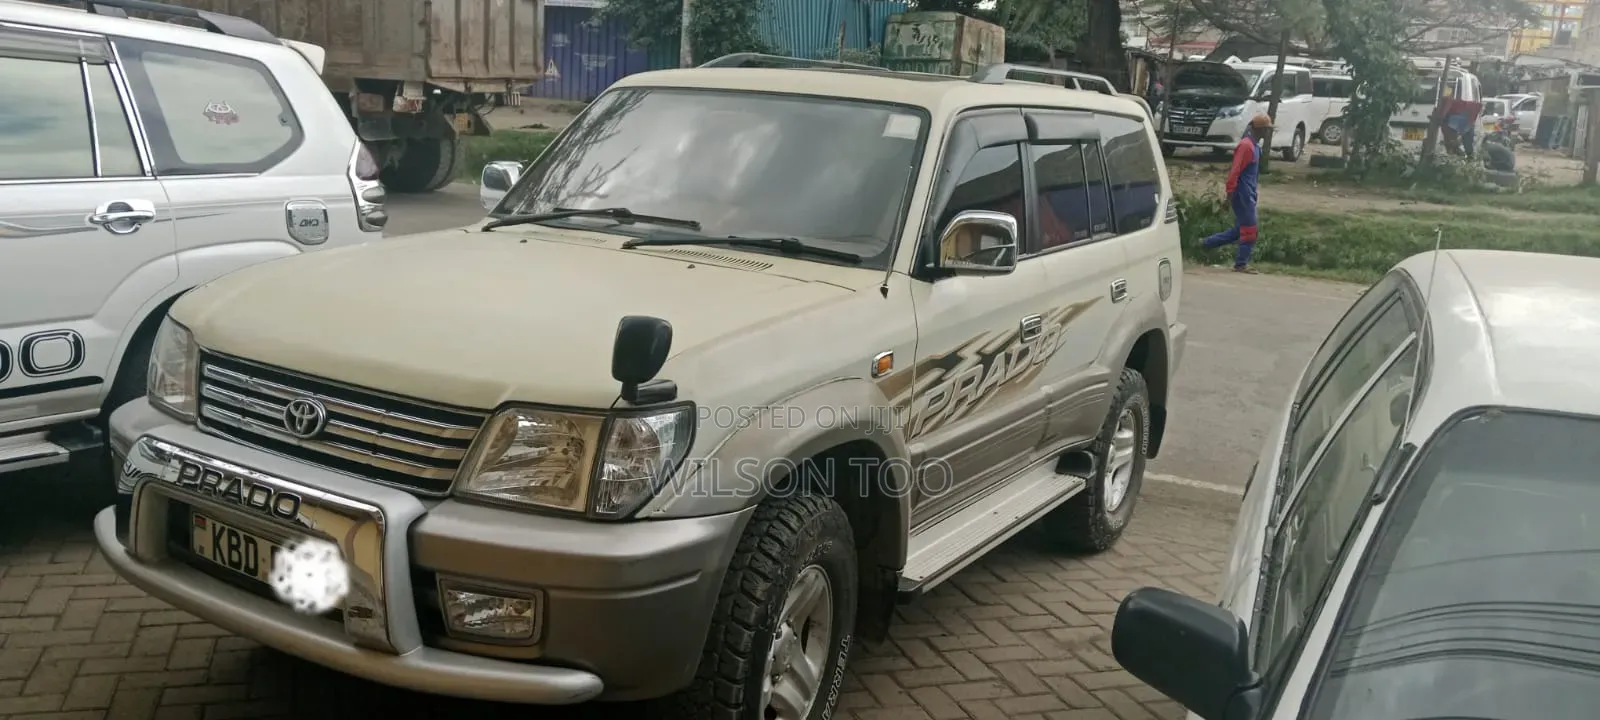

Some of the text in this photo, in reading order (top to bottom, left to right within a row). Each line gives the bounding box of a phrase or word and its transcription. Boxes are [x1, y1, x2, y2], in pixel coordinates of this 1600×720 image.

[911, 322, 1063, 438] PRADO
[177, 463, 302, 518] PRADO
[212, 523, 259, 577] KBD
